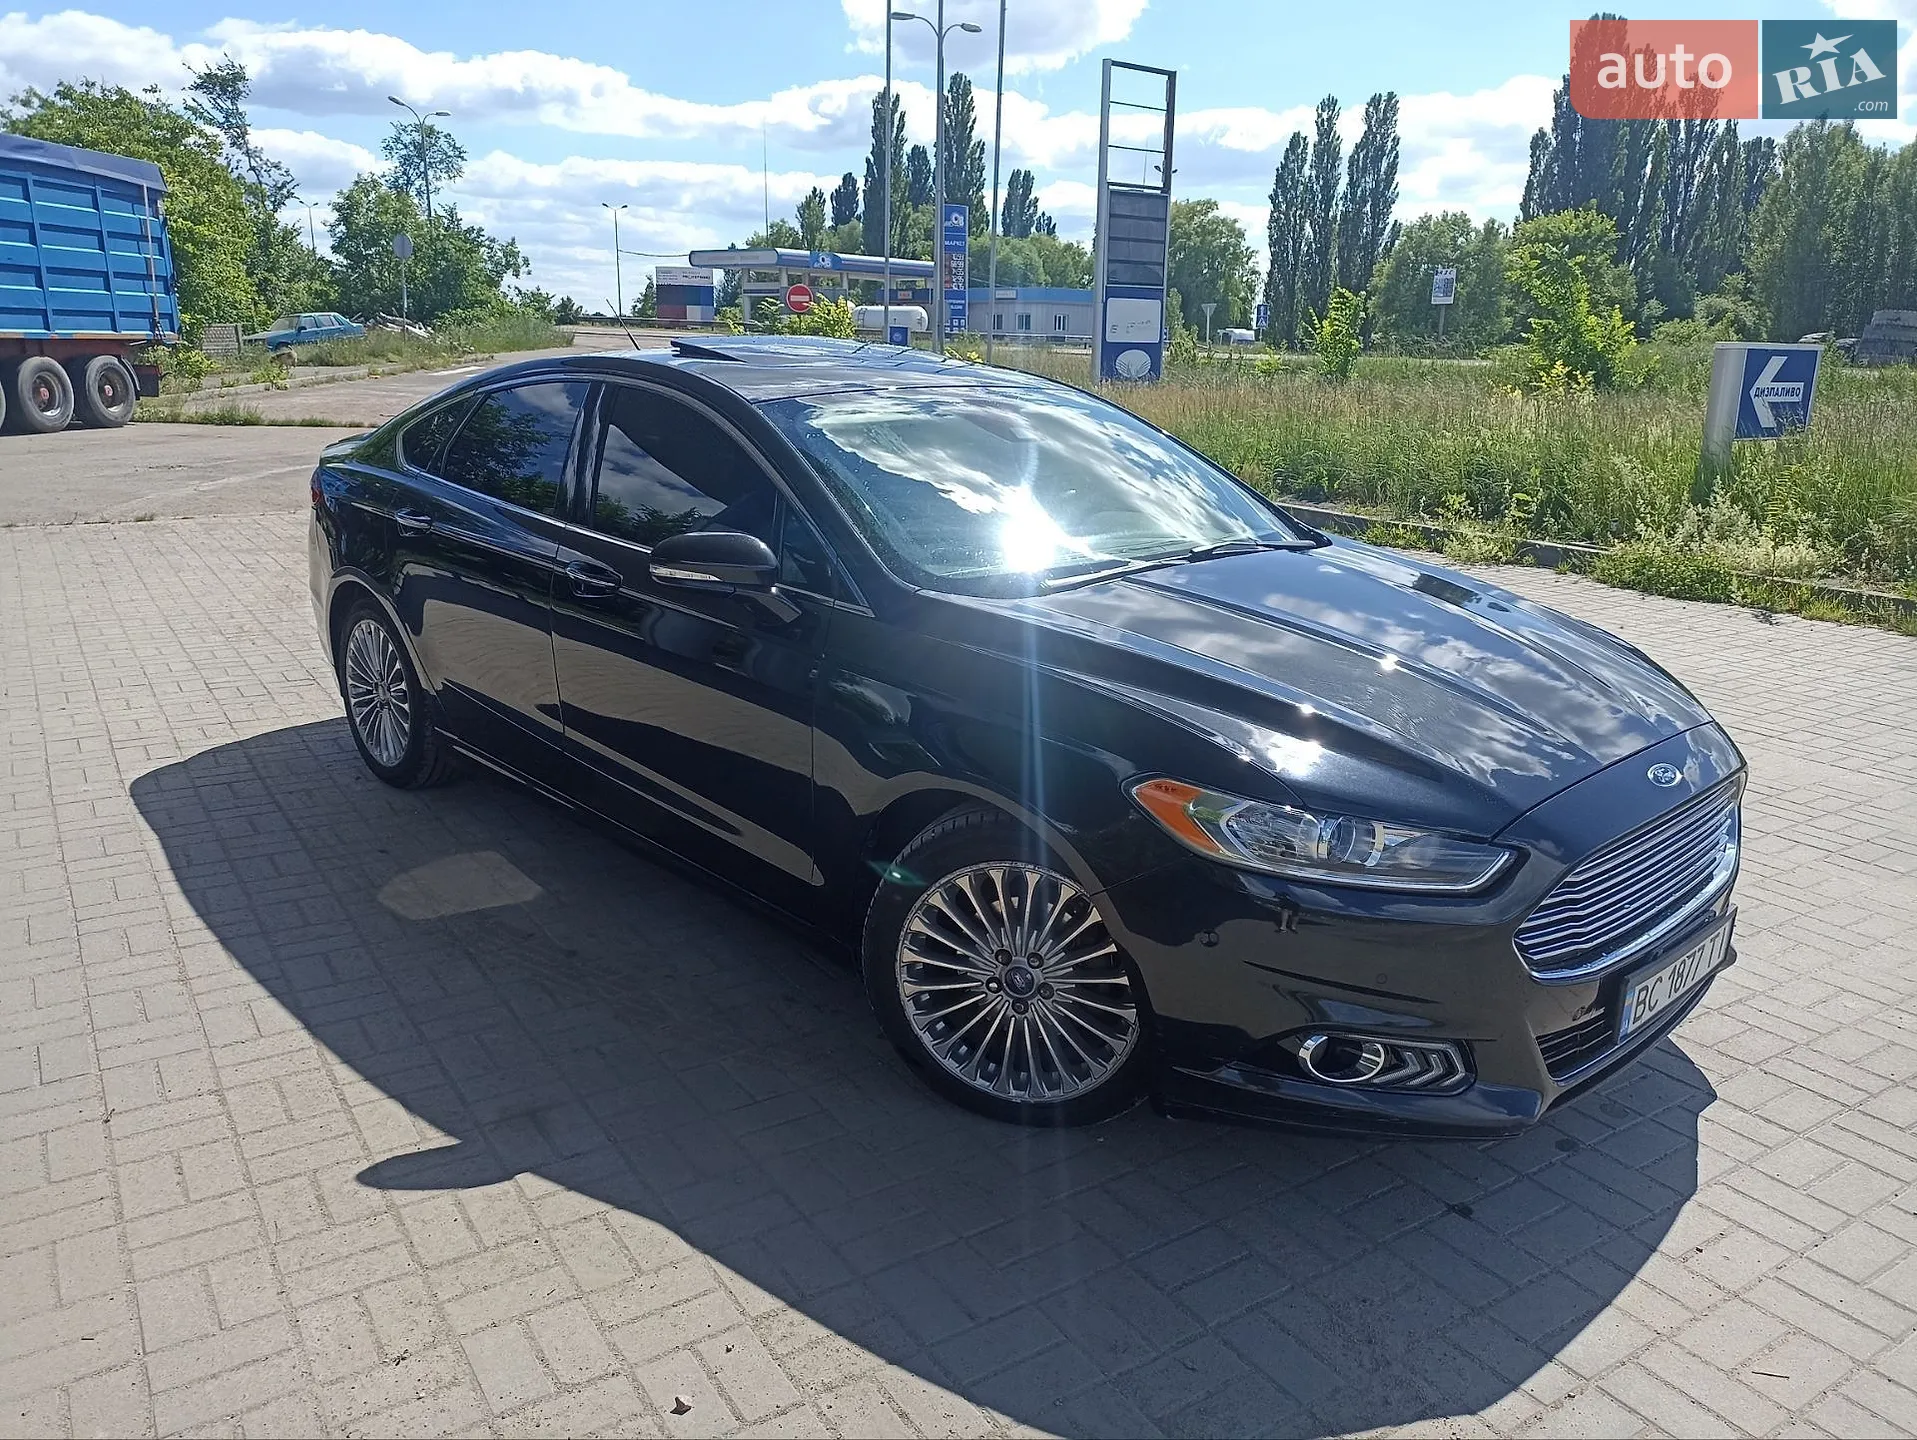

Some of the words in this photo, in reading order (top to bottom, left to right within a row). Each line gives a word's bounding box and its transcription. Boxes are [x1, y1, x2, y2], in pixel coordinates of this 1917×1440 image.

[1753, 386, 1801, 399] ДИЗПАЛИВО
[1632, 976, 1663, 1025] BC
[1667, 943, 1706, 999] 1877
